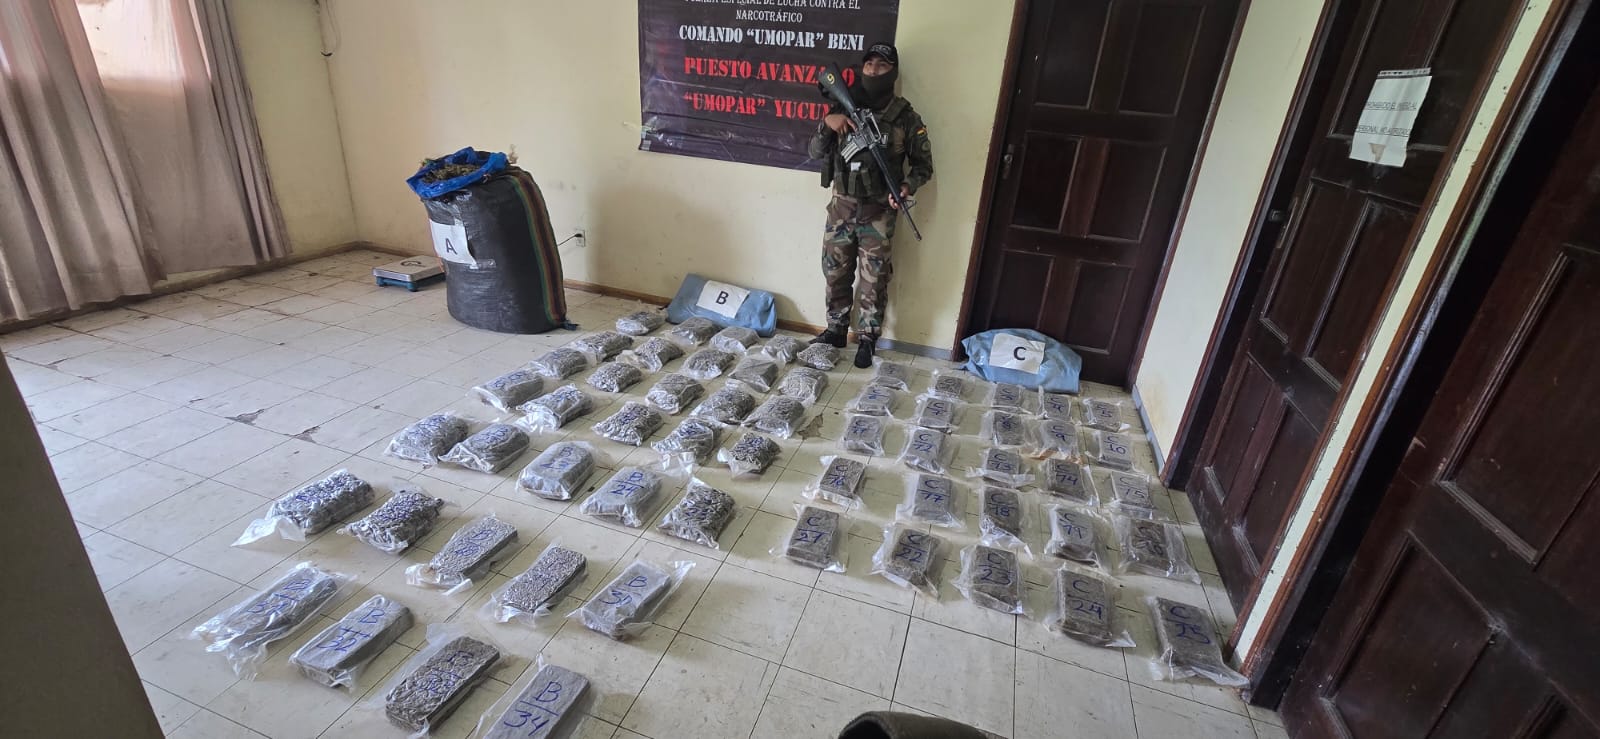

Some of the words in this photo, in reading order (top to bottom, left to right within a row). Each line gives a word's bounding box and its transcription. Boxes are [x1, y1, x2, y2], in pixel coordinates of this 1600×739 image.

[848, 0, 861, 10] EL
[736, 9, 803, 23] NARCOTRÁFICO
[679, 25, 743, 43] COMANDO
[747, 28, 824, 48] “UMOPAR”
[827, 33, 865, 51] BENI
[684, 56, 752, 78] PUESTO
[756, 62, 855, 88] AVANZO
[827, 73, 835, 85] 9
[683, 91, 766, 115] “UMOPAR”
[445, 238, 458, 255] A
[716, 290, 730, 305] B
[1013, 346, 1027, 361] C
[919, 433, 933, 441] C
[994, 453, 1008, 461] C
[1055, 464, 1070, 472] C
[628, 471, 644, 482] B
[1119, 477, 1134, 486] C
[924, 479, 942, 489] C
[609, 485, 638, 498] 24
[990, 493, 1004, 503] C
[806, 516, 822, 527] C
[1063, 512, 1077, 521] C
[907, 534, 922, 545] C
[895, 548, 922, 563] 22
[987, 551, 1002, 565] C
[624, 575, 648, 588] B
[980, 568, 1011, 586] 23
[1072, 579, 1090, 594] C
[358, 608, 385, 624] B
[1072, 600, 1102, 620] 24
[1170, 605, 1191, 619] C
[316, 635, 357, 652] 32
[532, 680, 563, 703] B
[503, 709, 550, 737] 34
